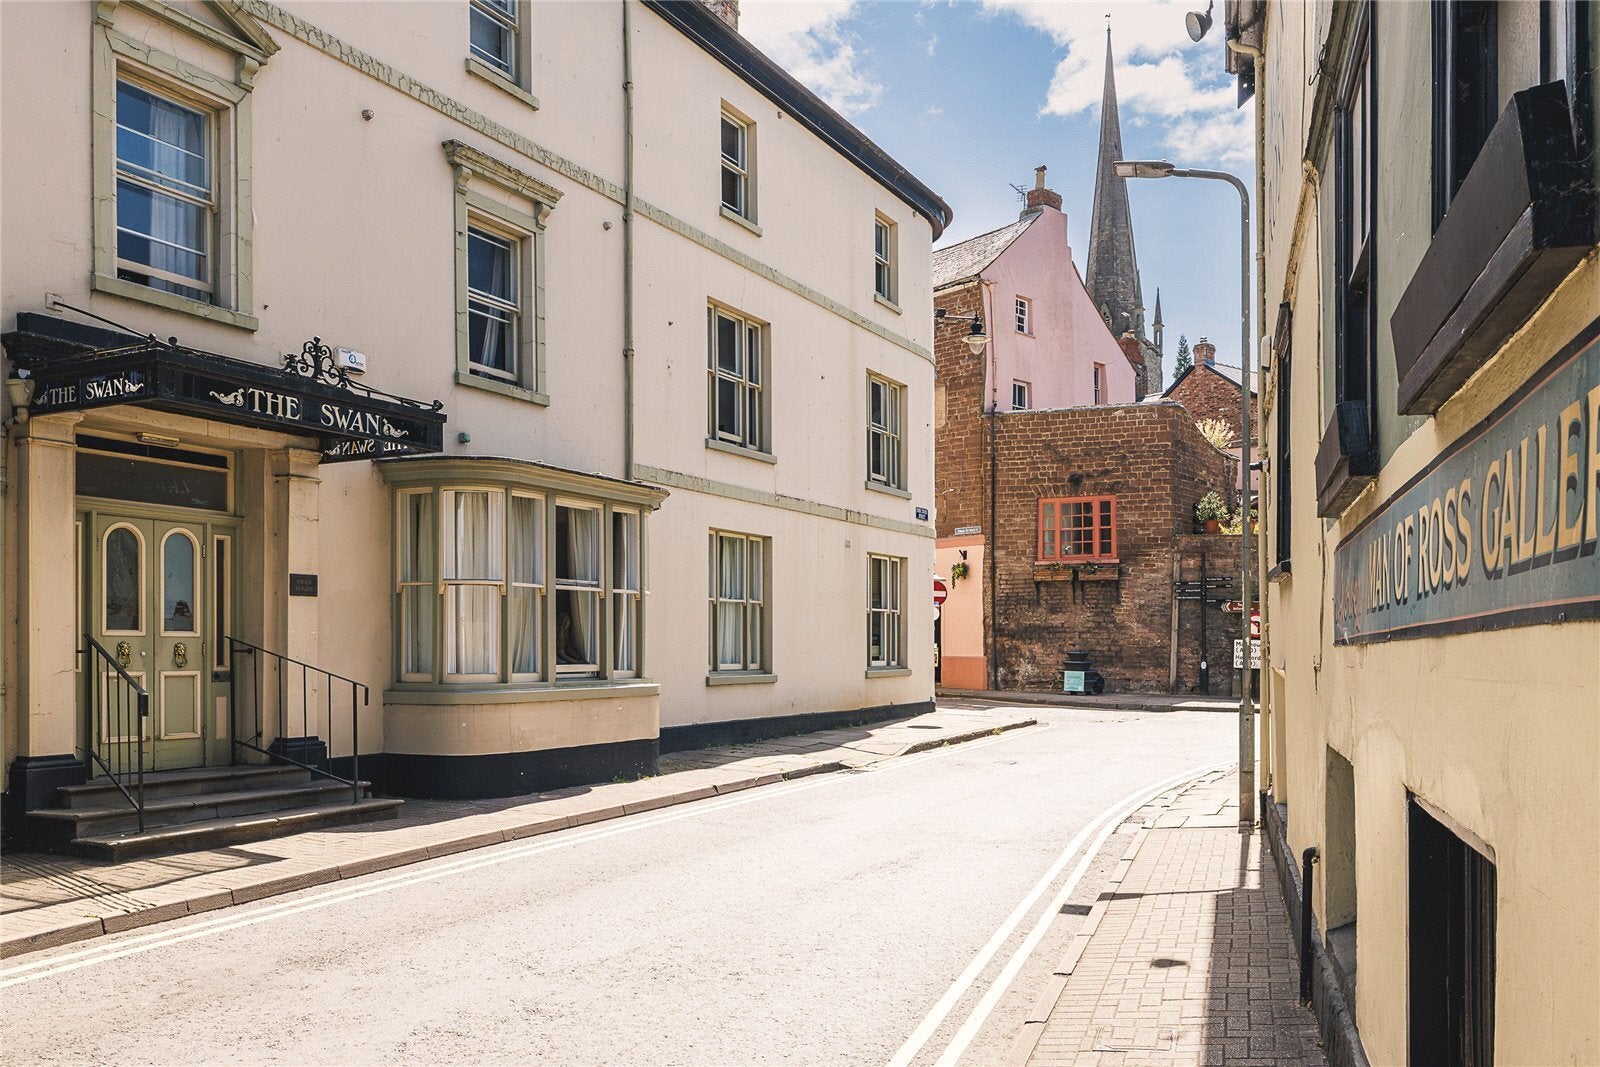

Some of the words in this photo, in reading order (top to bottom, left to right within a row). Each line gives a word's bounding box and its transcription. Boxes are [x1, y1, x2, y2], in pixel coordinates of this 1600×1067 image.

[49, 386, 77, 405] THE
[85, 378, 124, 400] SWAN
[248, 388, 300, 420] THE
[320, 403, 381, 436] SWAN
[1393, 515, 1415, 600] OF
[1419, 479, 1471, 593] ROSS
